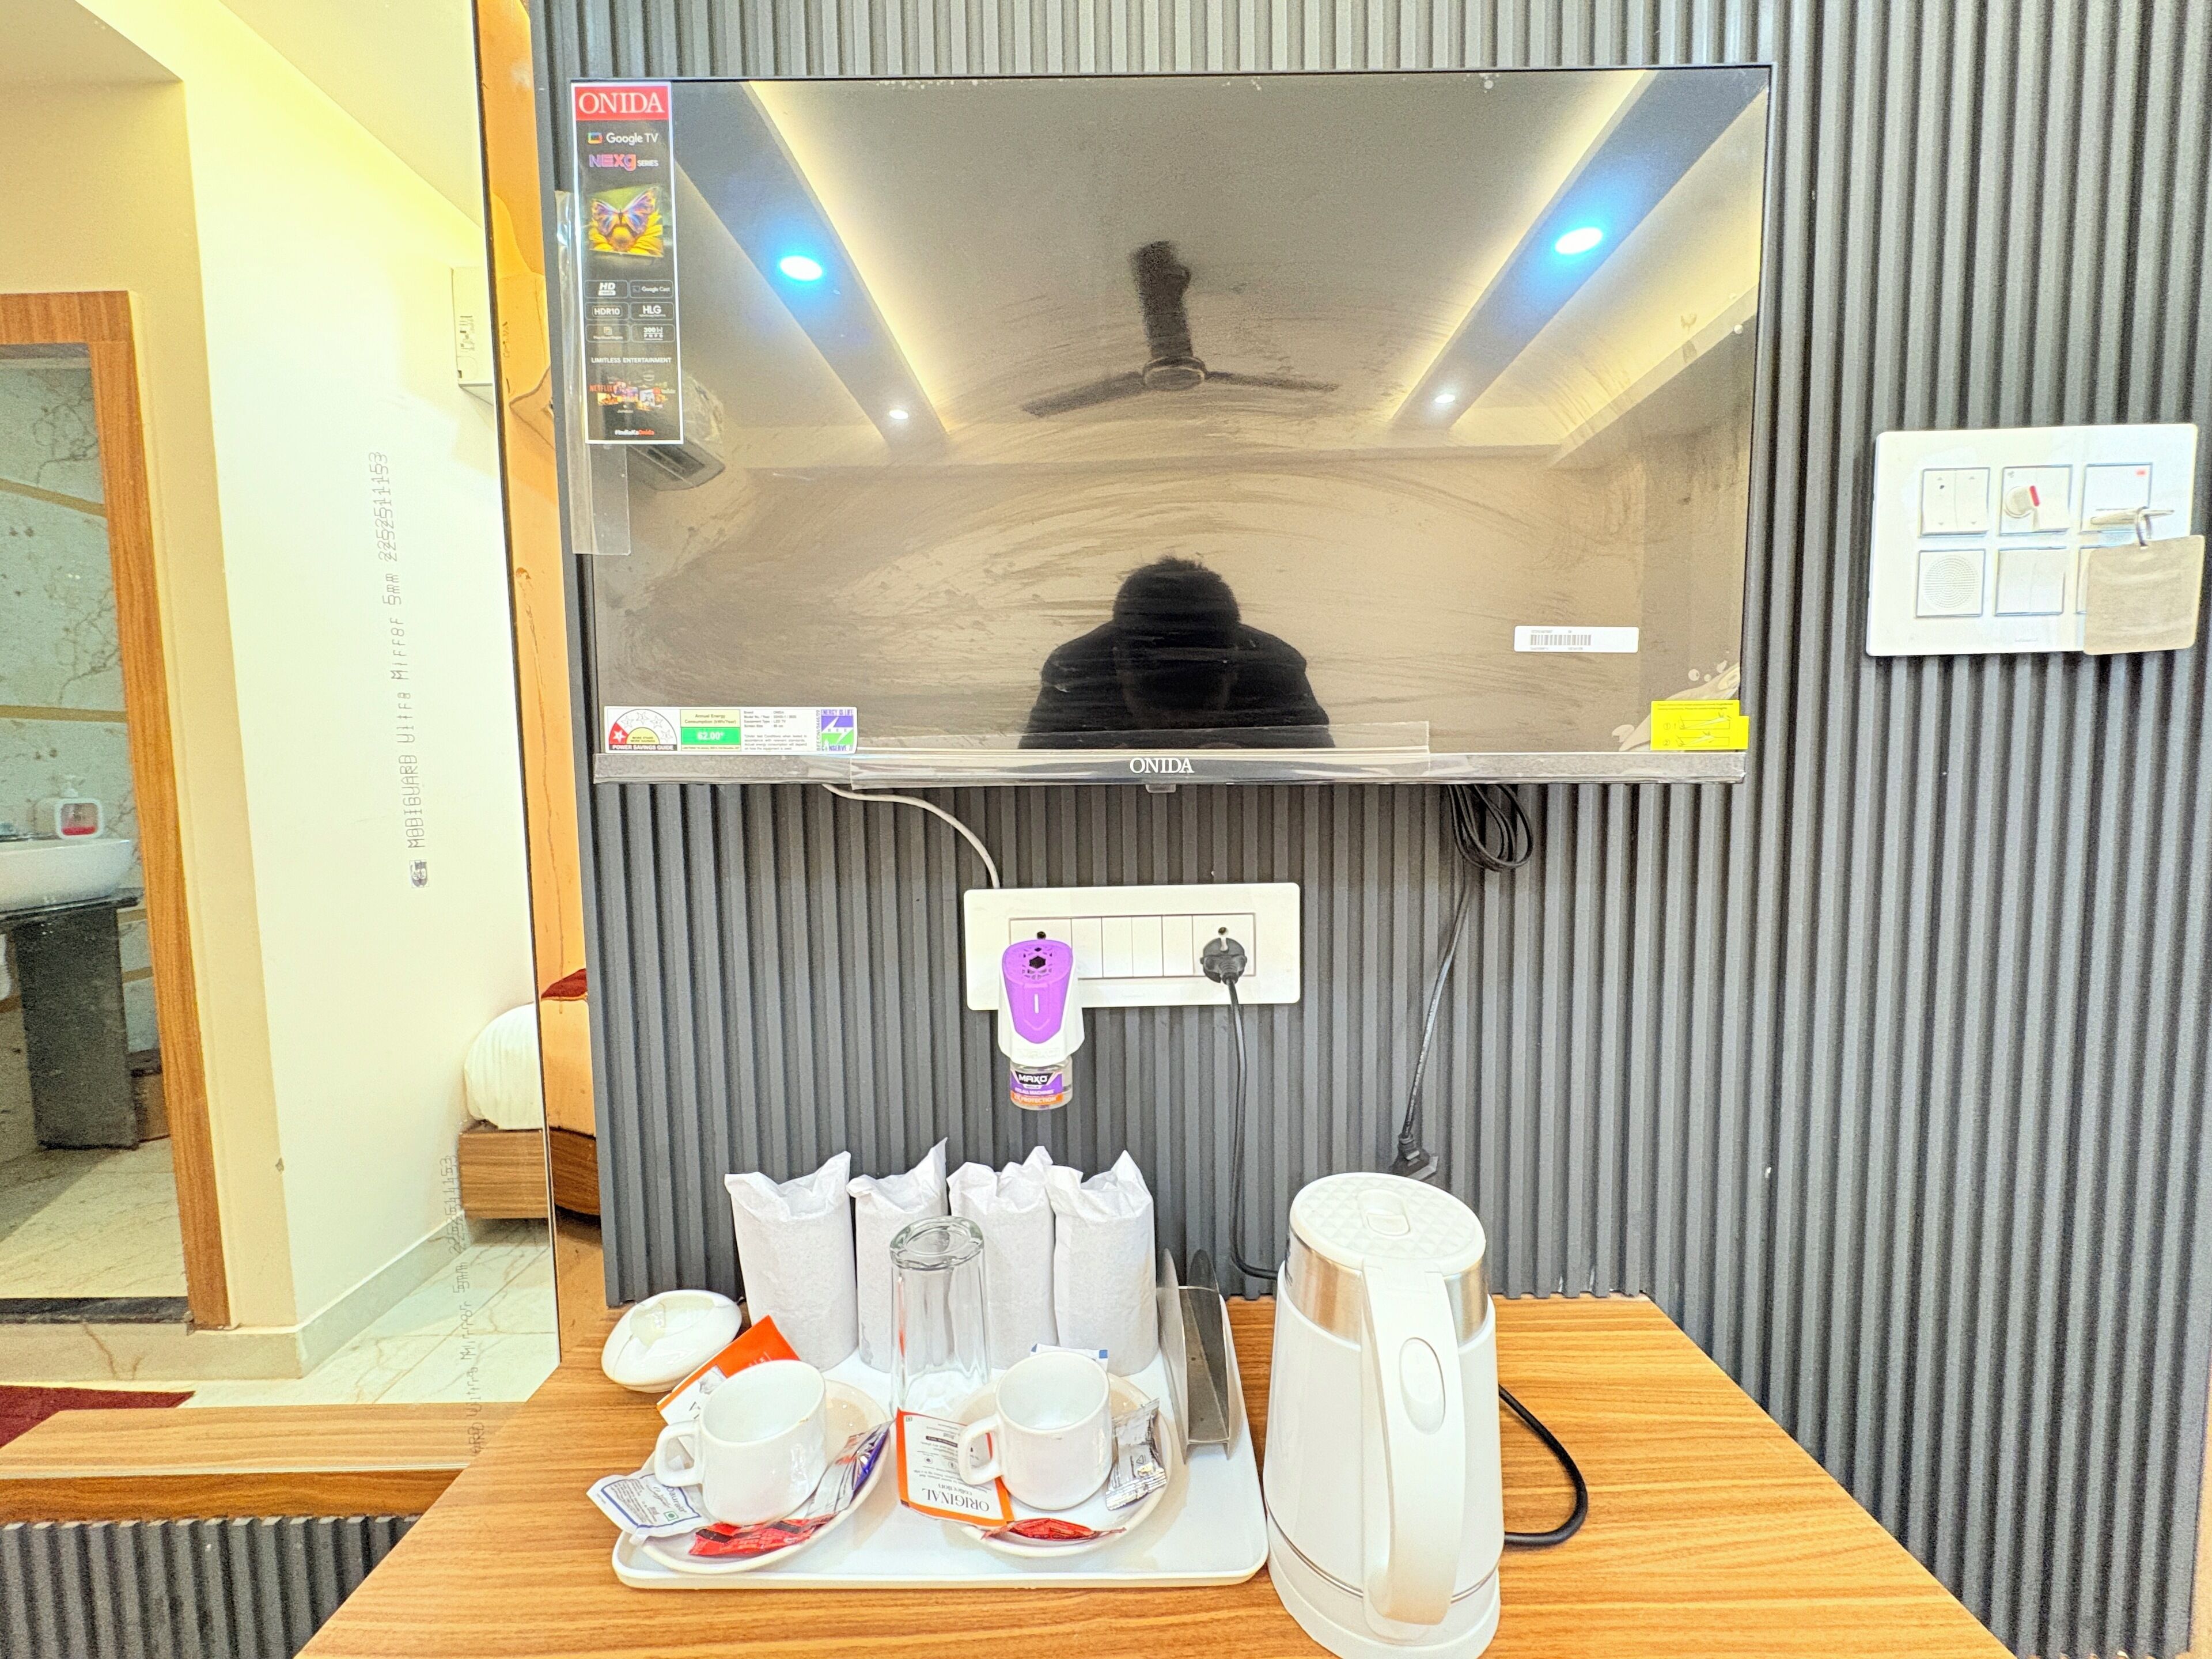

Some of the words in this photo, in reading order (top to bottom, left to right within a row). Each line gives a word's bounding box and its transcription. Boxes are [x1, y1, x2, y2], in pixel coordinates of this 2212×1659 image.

[578, 92, 665, 114] ONIDA
[606, 132, 643, 146] Google
[645, 133, 658, 143] TV
[642, 305, 662, 315] HLG
[1130, 757, 1195, 774] ONIDA
[1018, 1074, 1048, 1085] MAXO
[460, 1301, 476, 1360] Mirror
[922, 1488, 990, 1512] ORIGINAL
